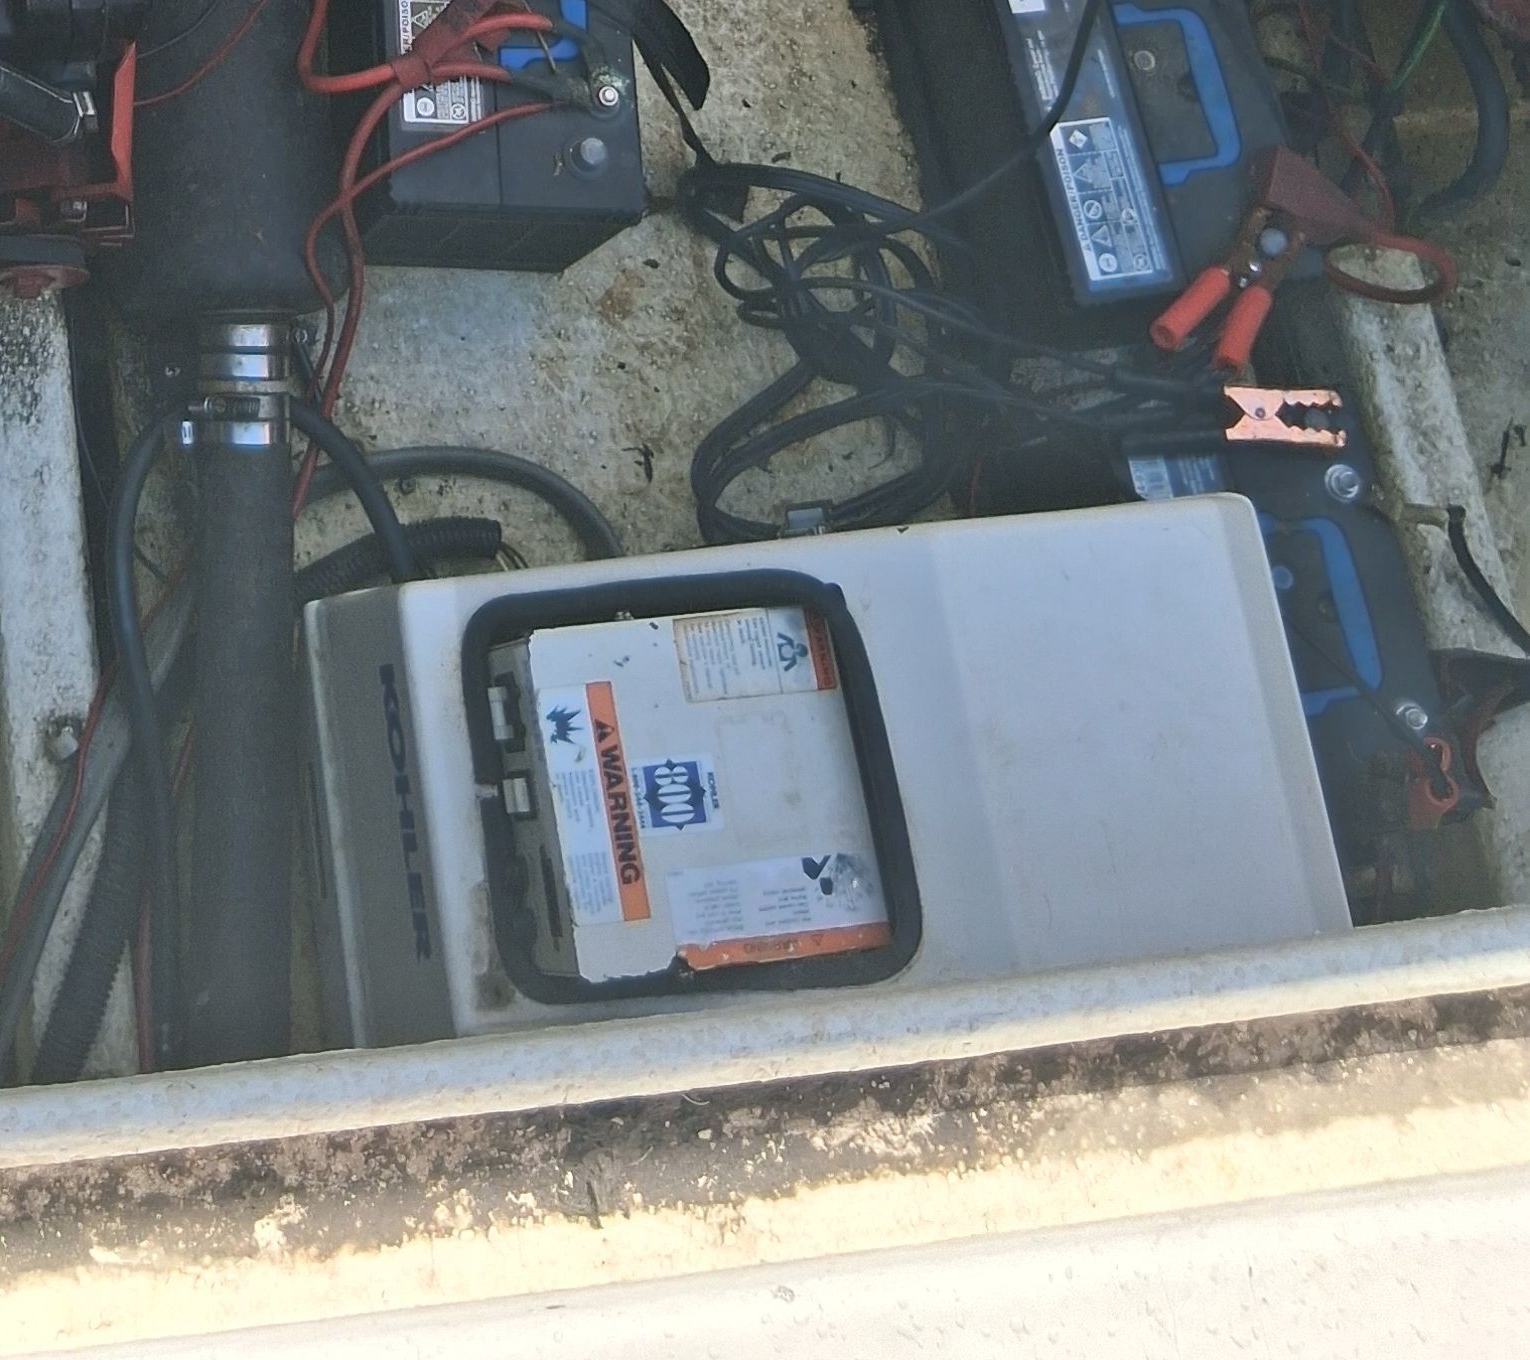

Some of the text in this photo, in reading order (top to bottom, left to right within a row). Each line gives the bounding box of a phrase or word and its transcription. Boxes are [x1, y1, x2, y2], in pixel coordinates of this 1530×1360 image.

[1055, 147, 1087, 243] DANGER/POISON
[379, 663, 431, 963] KOHLER
[599, 744, 641, 886] WARNING
[653, 765, 695, 825] 800
